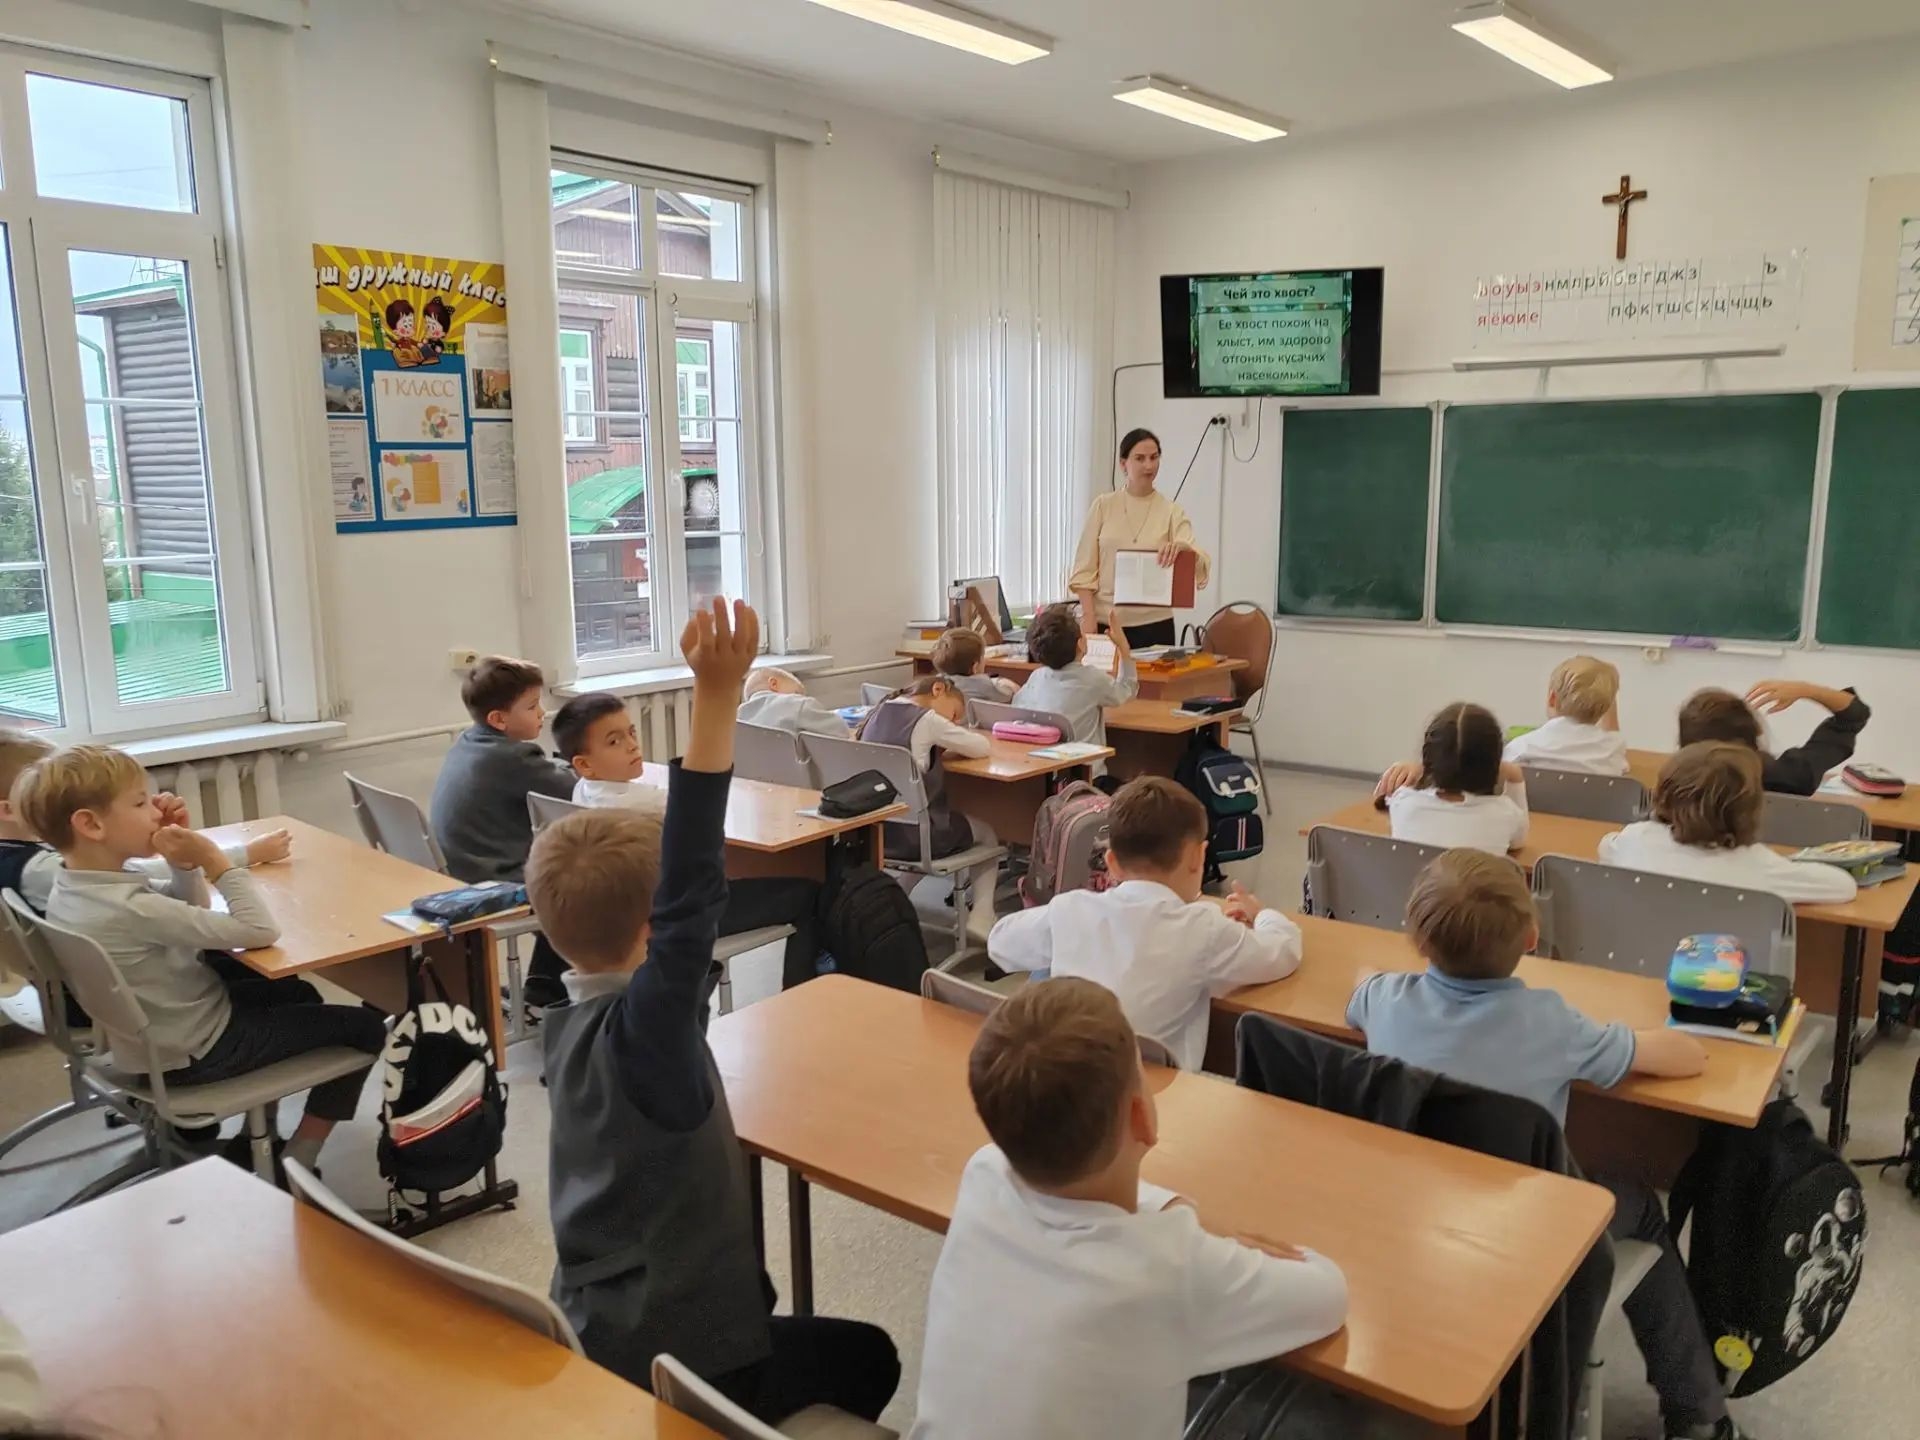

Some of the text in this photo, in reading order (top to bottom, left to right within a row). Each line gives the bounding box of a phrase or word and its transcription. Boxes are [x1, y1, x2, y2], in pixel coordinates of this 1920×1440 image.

[346, 261, 453, 293] дружный
[1223, 285, 1316, 300] Чей это хвост?
[1235, 319, 1268, 330] хвост
[1271, 317, 1312, 329] похож
[1314, 317, 1330, 328] на
[1216, 335, 1332, 348] хлыст, им здорово
[1222, 352, 1327, 365] отгонять кусачих
[1237, 370, 1310, 382] насекомых.
[396, 378, 456, 398] КЛАСС
